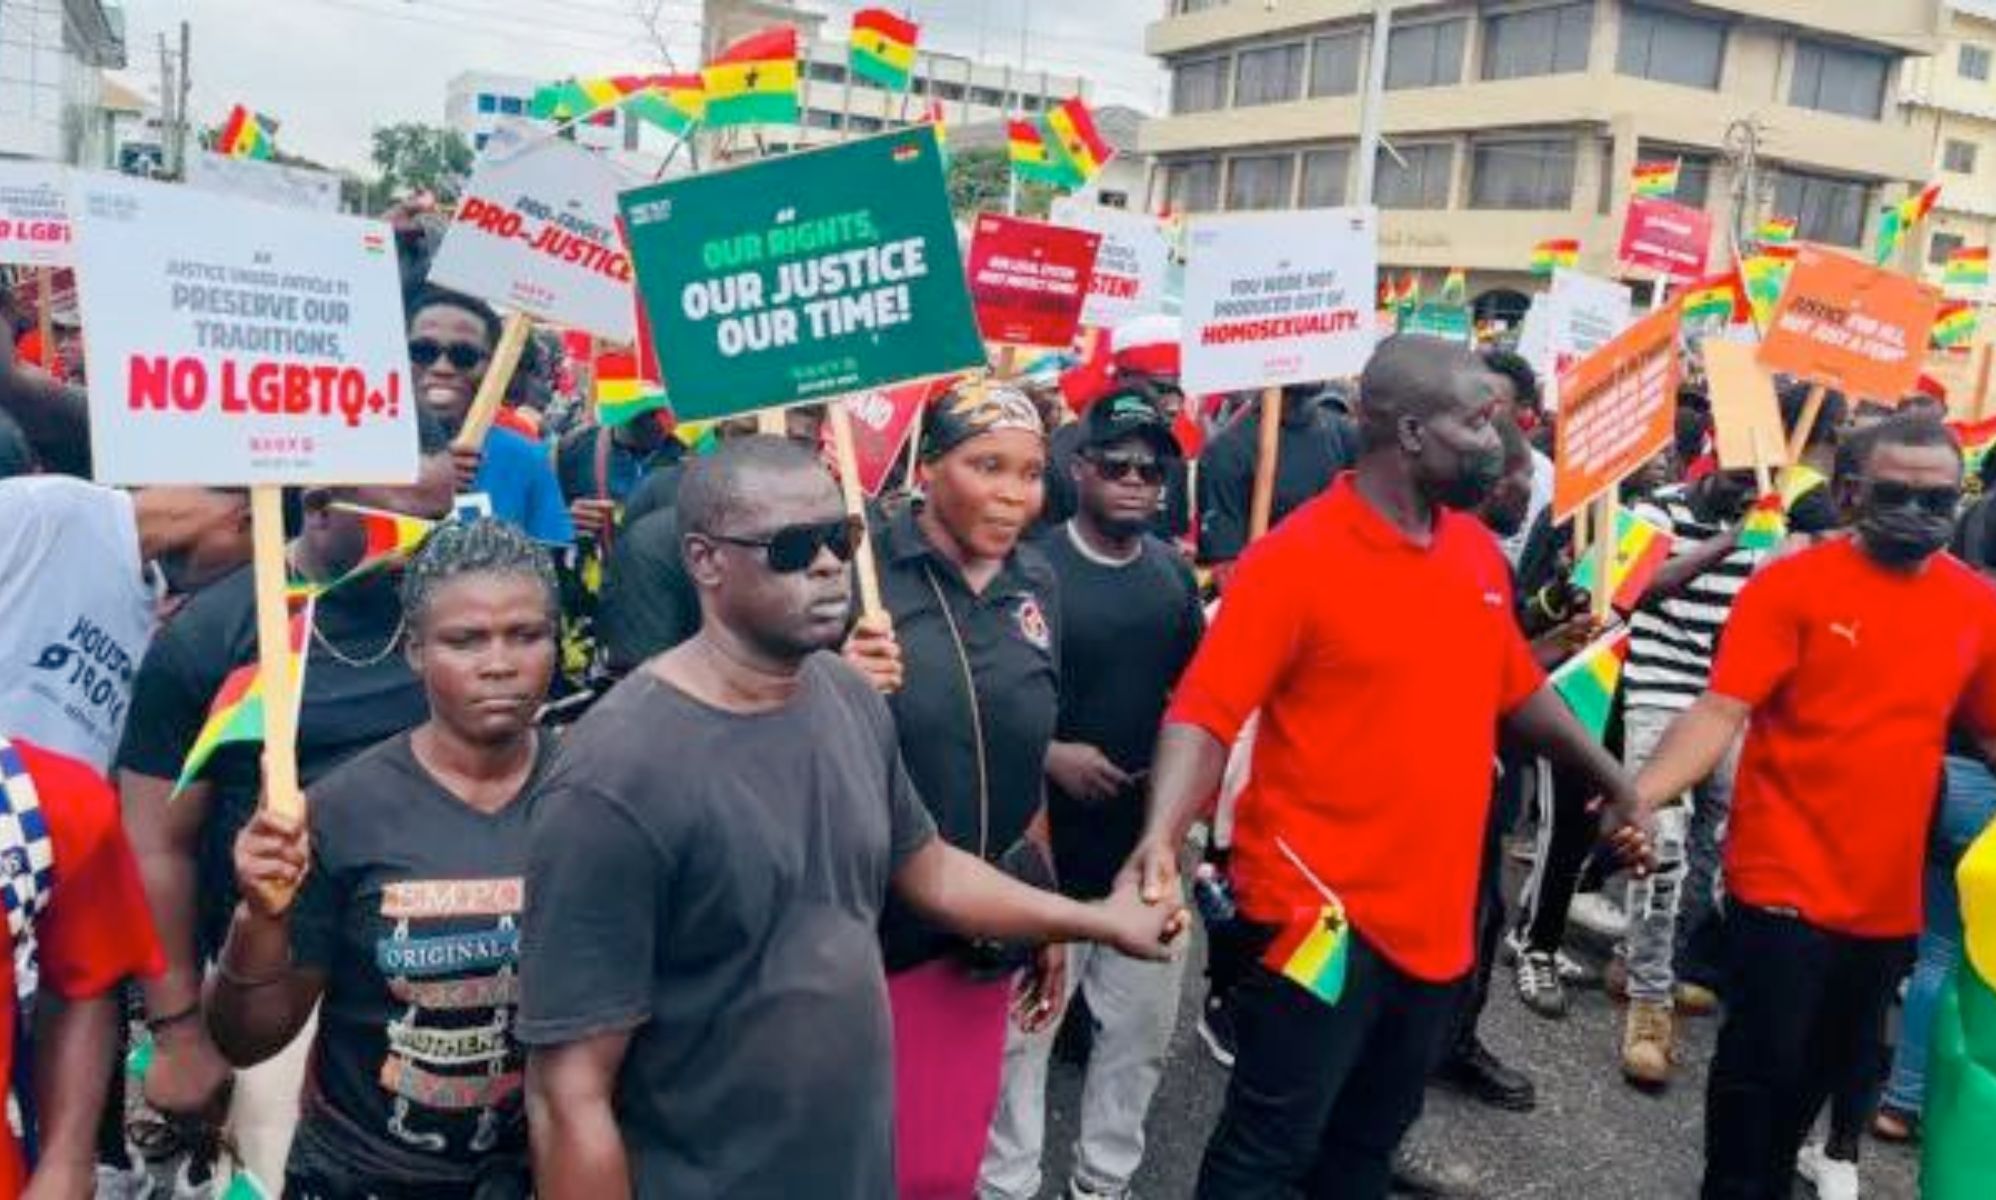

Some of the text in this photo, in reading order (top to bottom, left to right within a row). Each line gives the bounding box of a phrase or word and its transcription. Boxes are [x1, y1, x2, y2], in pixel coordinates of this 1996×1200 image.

[703, 209, 880, 269] OUR RIGHTS,
[165, 260, 225, 283] JUSTICE
[682, 273, 764, 320] OUR
[771, 236, 928, 304] JUSTICE
[172, 283, 349, 325] PRESERVE OUR
[717, 284, 912, 357] OUR TIME!
[1214, 295, 1291, 317] PRODUCED
[196, 320, 345, 363] TRADITIONS,
[128, 354, 400, 427] NO LGBTQ+!
[386, 938, 503, 968] ORIGINAL
